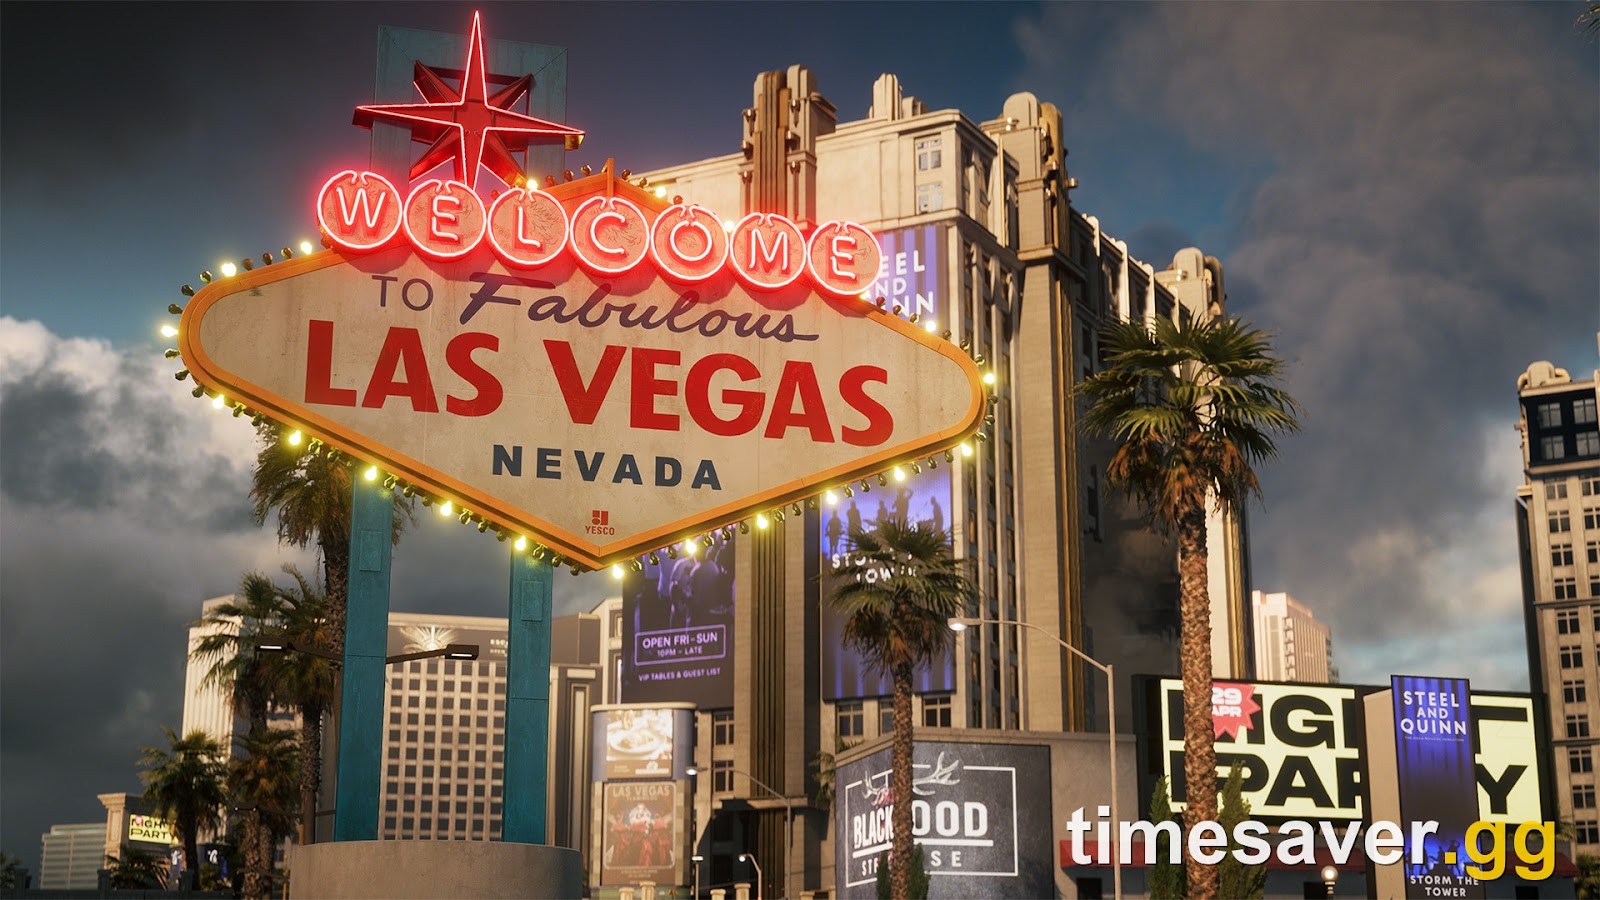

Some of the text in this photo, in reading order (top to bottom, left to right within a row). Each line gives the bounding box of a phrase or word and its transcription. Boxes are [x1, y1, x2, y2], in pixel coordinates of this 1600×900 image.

[334, 185, 859, 281] WELCOME
[879, 250, 926, 279] EEL
[371, 274, 435, 312] TO
[459, 271, 820, 343] Fabulous
[304, 318, 895, 447] LAS VEGAS
[491, 444, 722, 491] NEVADA
[585, 525, 615, 536] YESCO
[642, 636, 671, 649] OPEN
[657, 648, 676, 657] 10PM
[684, 646, 703, 656] LATE
[639, 673, 650, 681] VIP
[651, 671, 675, 680] TABLES
[683, 668, 705, 678] GUEST
[706, 667, 721, 676] LIST
[1403, 690, 1460, 708] STEEL
[1212, 705, 1242, 717] APR
[1416, 706, 1448, 719] AND
[1400, 718, 1467, 735] QUINN
[612, 785, 670, 797] LAS VEGAS
[1410, 875, 1479, 886] STORM THE
[1425, 887, 1466, 897] TOWER
